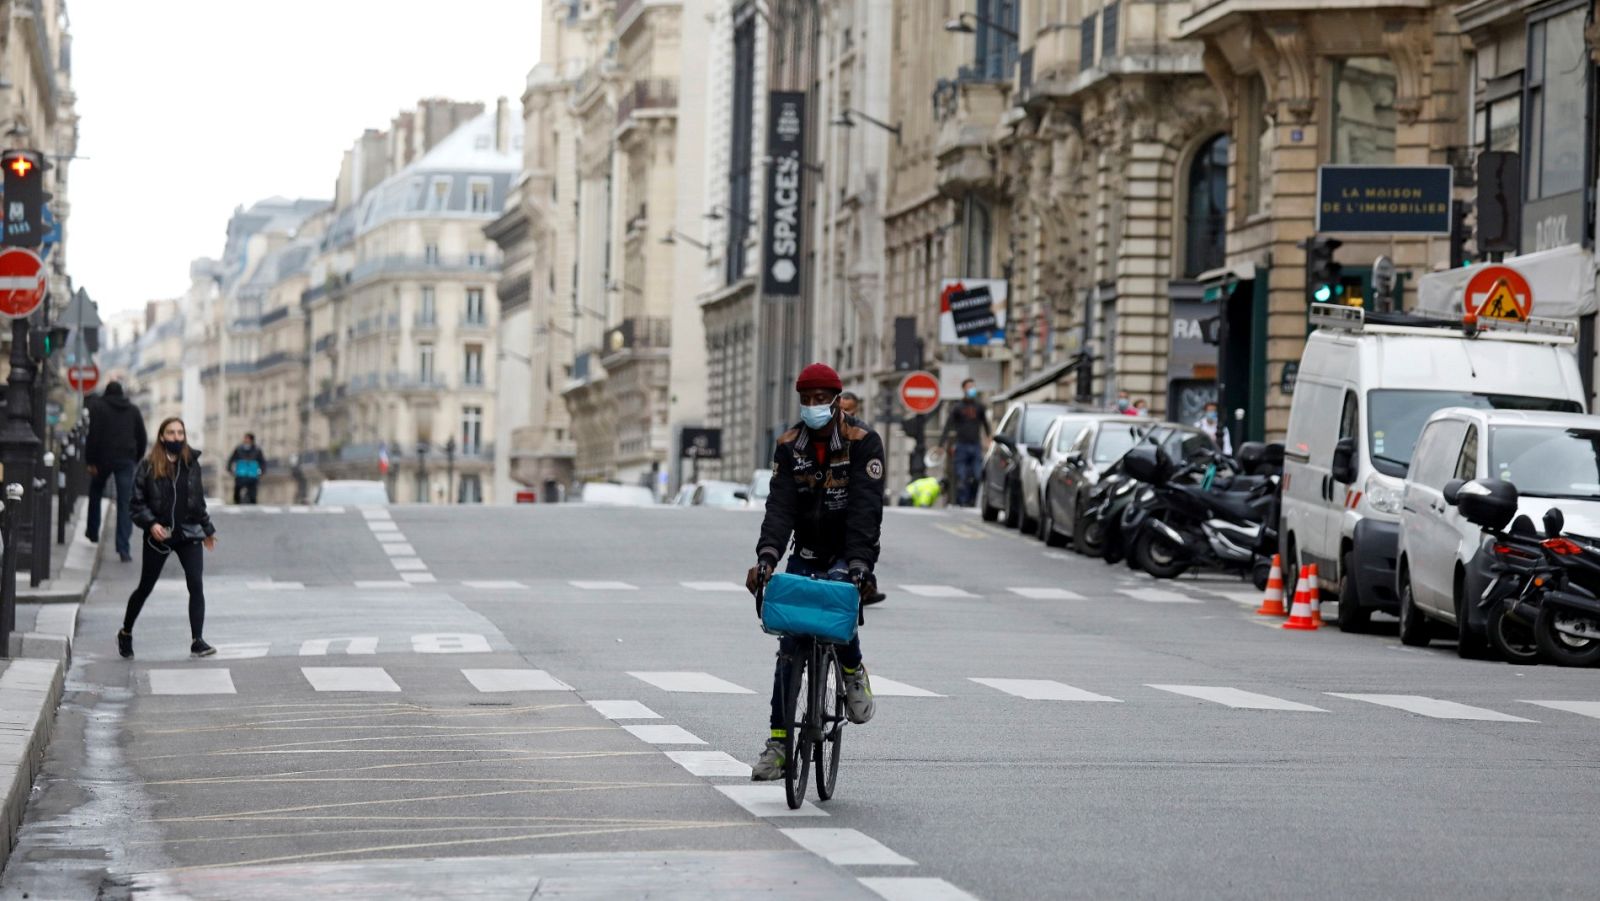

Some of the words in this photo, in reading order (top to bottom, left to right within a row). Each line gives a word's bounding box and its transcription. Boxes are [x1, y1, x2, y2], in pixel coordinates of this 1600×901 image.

[1342, 187, 1360, 199] LA
[1364, 187, 1422, 199] MAISON
[1322, 202, 1341, 214] DE
[1346, 202, 1447, 214] L'IMMOBILIER
